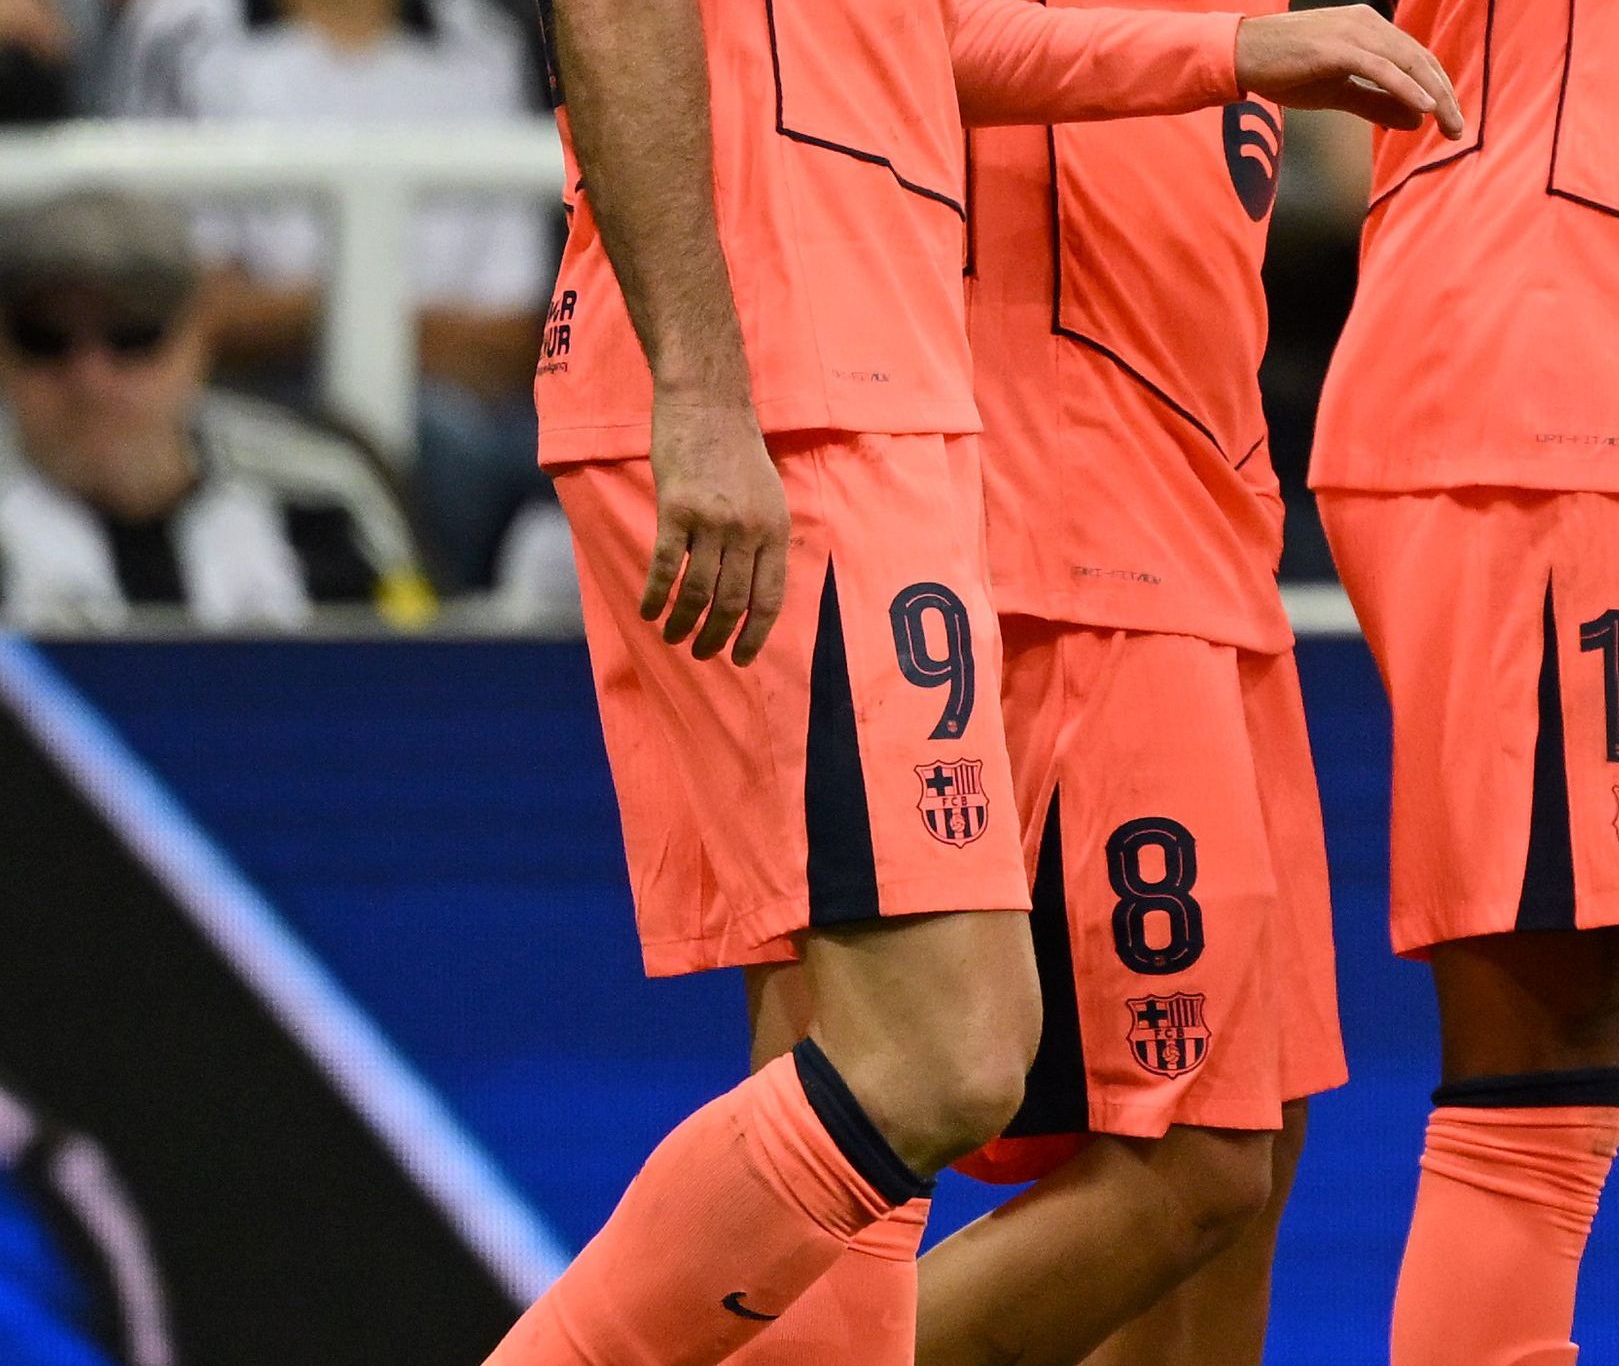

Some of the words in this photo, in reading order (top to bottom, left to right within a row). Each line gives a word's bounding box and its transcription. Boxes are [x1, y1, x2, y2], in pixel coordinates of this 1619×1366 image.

[889, 582, 975, 741] 9
[942, 795, 968, 807] FCB
[1105, 816, 1205, 976] 8
